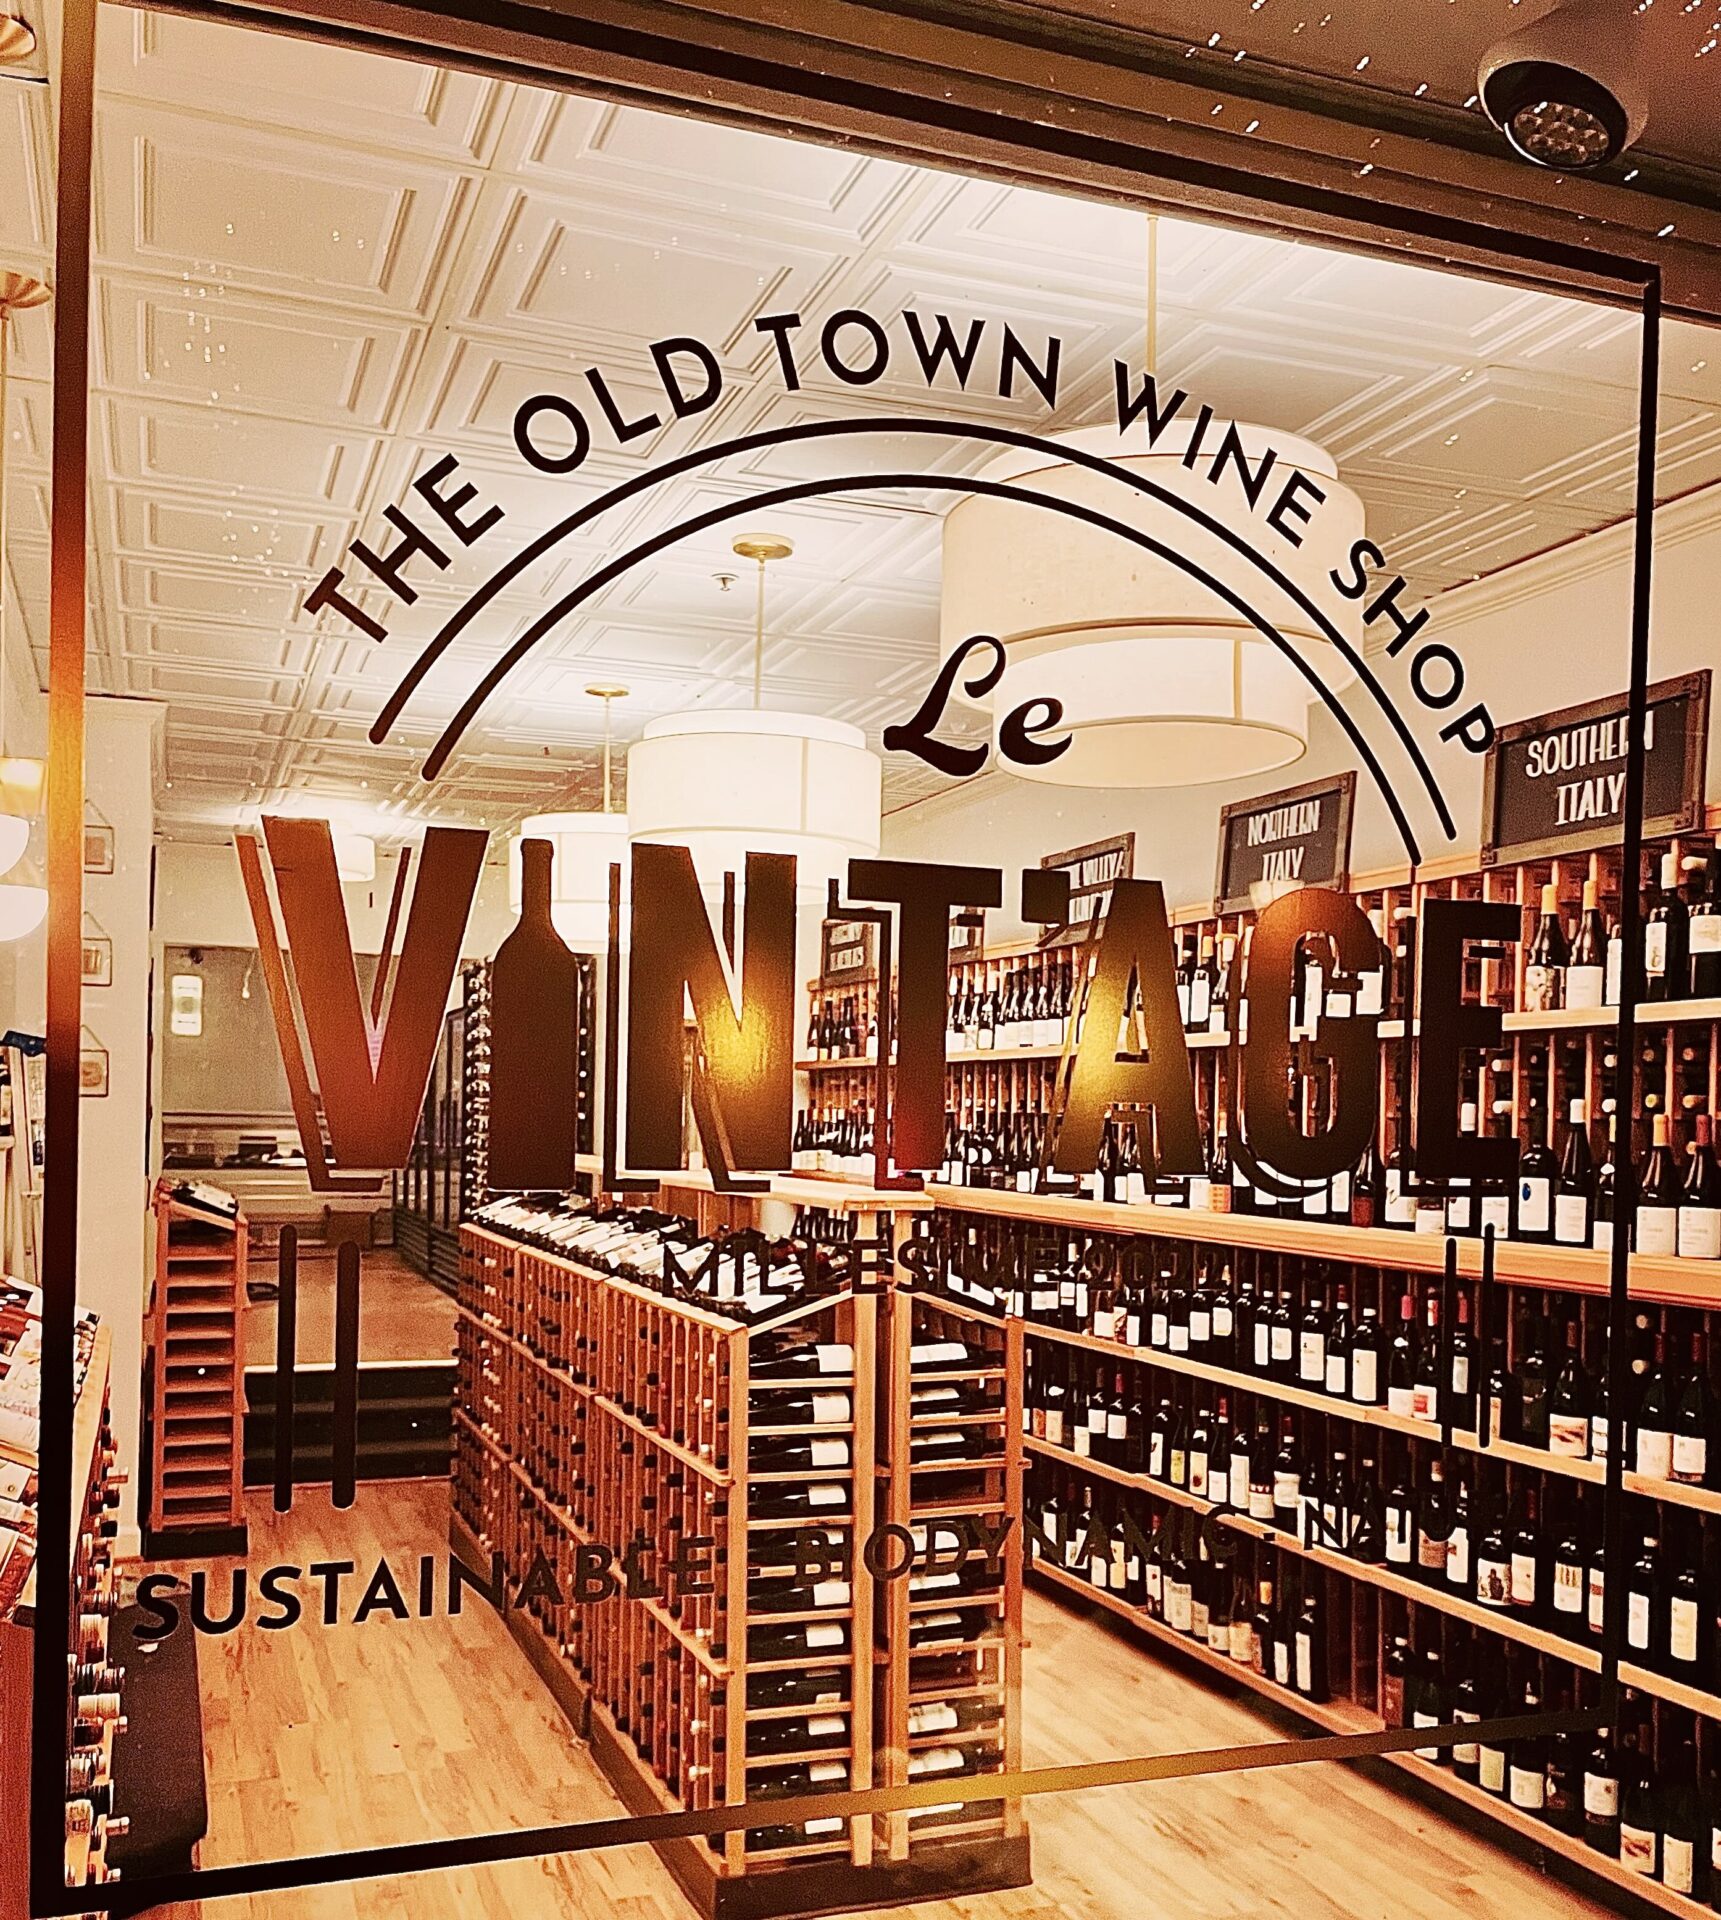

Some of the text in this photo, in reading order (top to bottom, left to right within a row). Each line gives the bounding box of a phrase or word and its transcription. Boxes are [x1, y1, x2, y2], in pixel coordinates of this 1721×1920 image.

[303, 309, 1496, 754] THE OLD TOWN WINE SHOP
[883, 635, 1073, 776] Le
[1247, 799, 1321, 847] NORTHERN
[1554, 772, 1627, 826] ITALY
[1261, 846, 1305, 881] ITALY
[132, 1536, 717, 1640] SUSTAINABLE
[794, 1504, 1238, 1586] BIODYNAMIC
